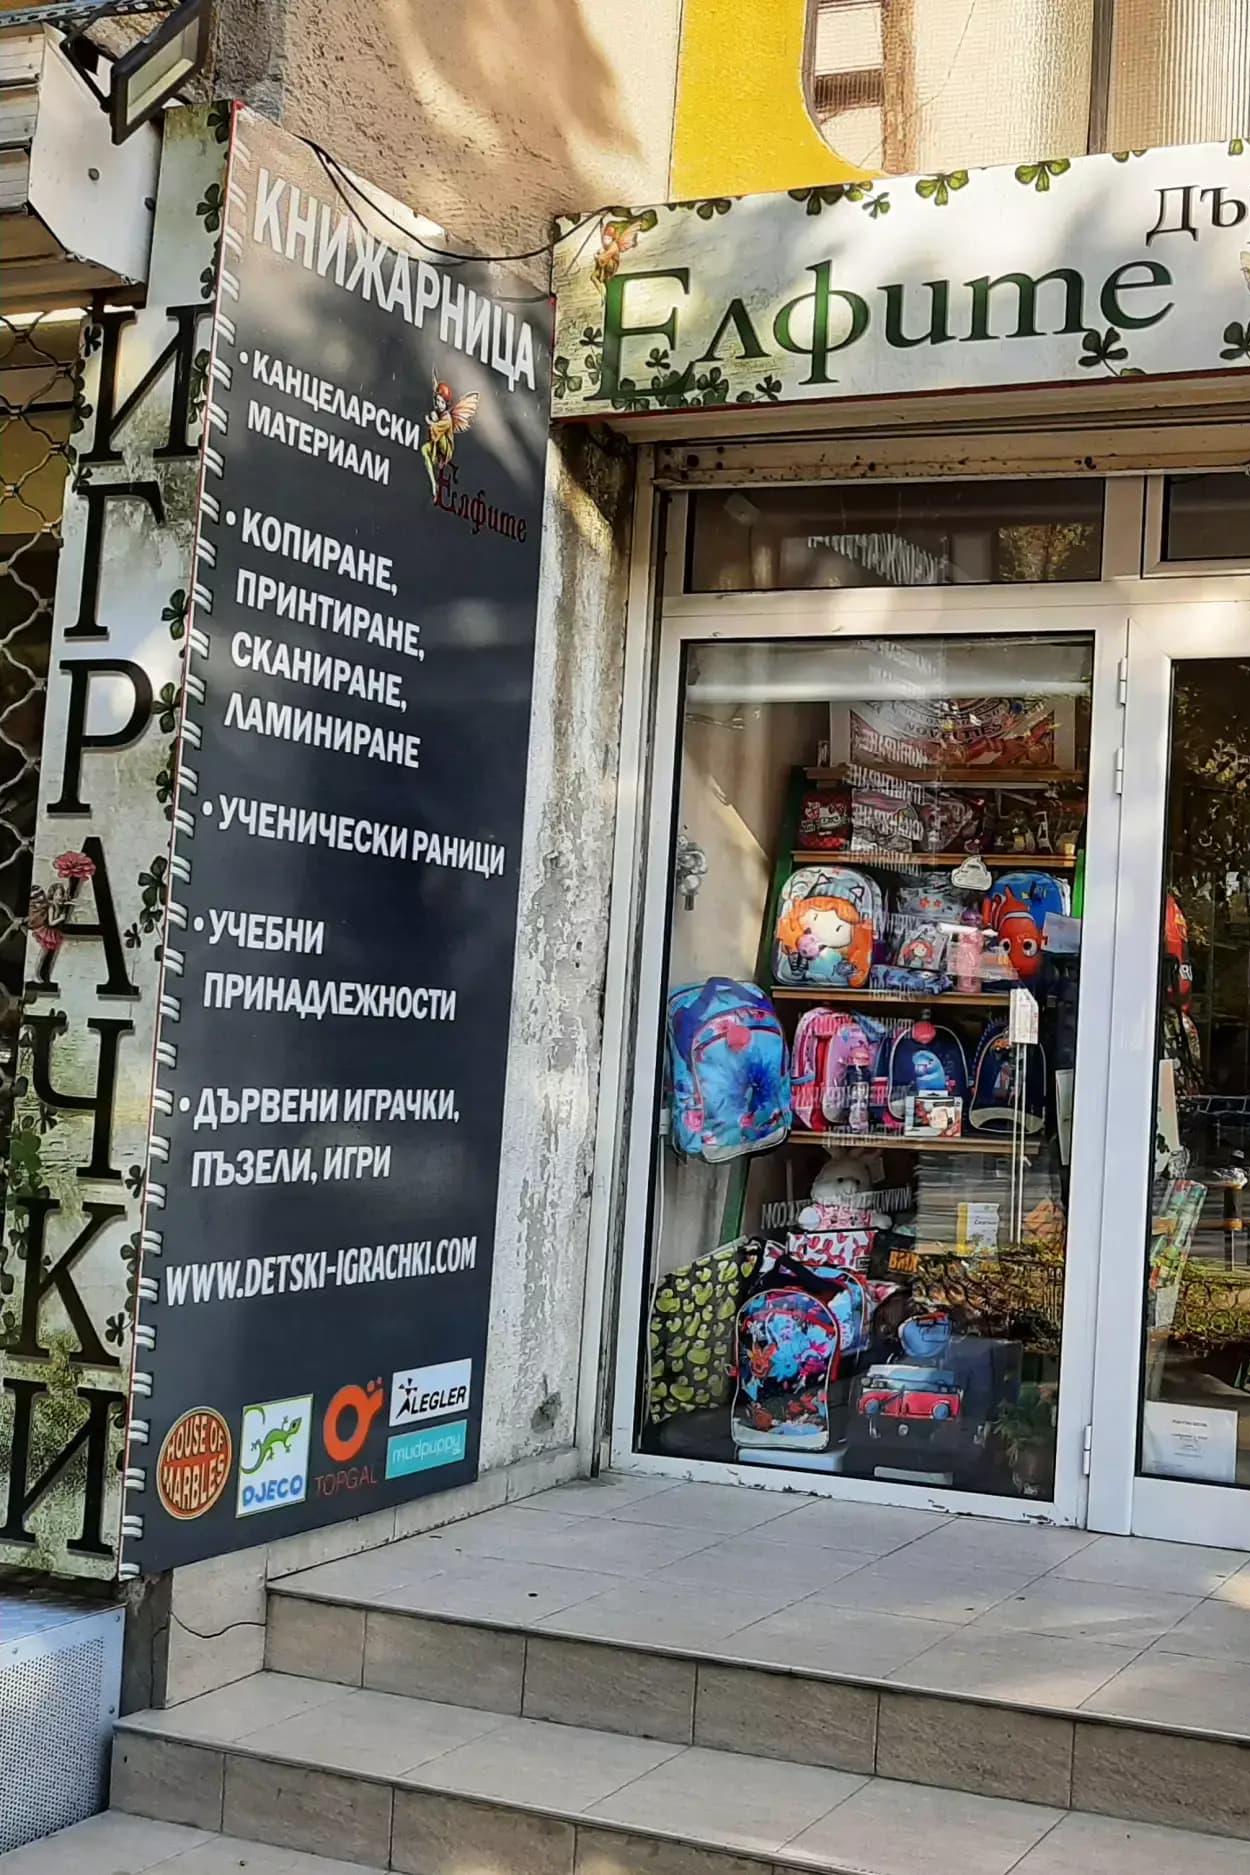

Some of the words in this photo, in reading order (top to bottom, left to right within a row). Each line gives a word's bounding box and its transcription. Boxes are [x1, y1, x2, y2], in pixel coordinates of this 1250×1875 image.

[253, 167, 536, 392] КНИЖАРНИЦА
[583, 258, 1176, 402] Елфите
[251, 350, 421, 451] КАНЦЕЛАРСКИ
[247, 400, 391, 486] МАТЕРИАЛИ
[241, 507, 399, 595] КОПИРАНЕ,
[236, 568, 426, 662] ПРИНТИРАНЕ,
[231, 630, 408, 713] СКАНИРАНЕ,
[223, 690, 421, 768] ЛАМИНИРАНЕ
[218, 794, 408, 860] УЧЕНИЧЕСКИ
[411, 832, 505, 879] РАНИЦИ
[0, 302, 214, 1556] ИГРАЧКИ
[208, 909, 325, 956] УЧЕБНИ
[203, 972, 457, 1021] ПРИНАДЛЕЖНОСТИ
[193, 1087, 341, 1130] ДЪРВЕНИ
[343, 1088, 460, 1123] ИГРАЧКИ,
[191, 1147, 317, 1188] ПЪЗЕЛИ,
[322, 1146, 392, 1180] ИГРИ
[165, 1236, 478, 1306] WWW.DETSKI-IGRACHKI.COM
[166, 1415, 206, 1461] HOUSE
[209, 1418, 224, 1450] OF
[391, 1433, 461, 1463] mudpuppy
[163, 1454, 225, 1510] MARBLES
[242, 1474, 304, 1507] DJECO
[314, 1464, 377, 1496] TOPGAL
